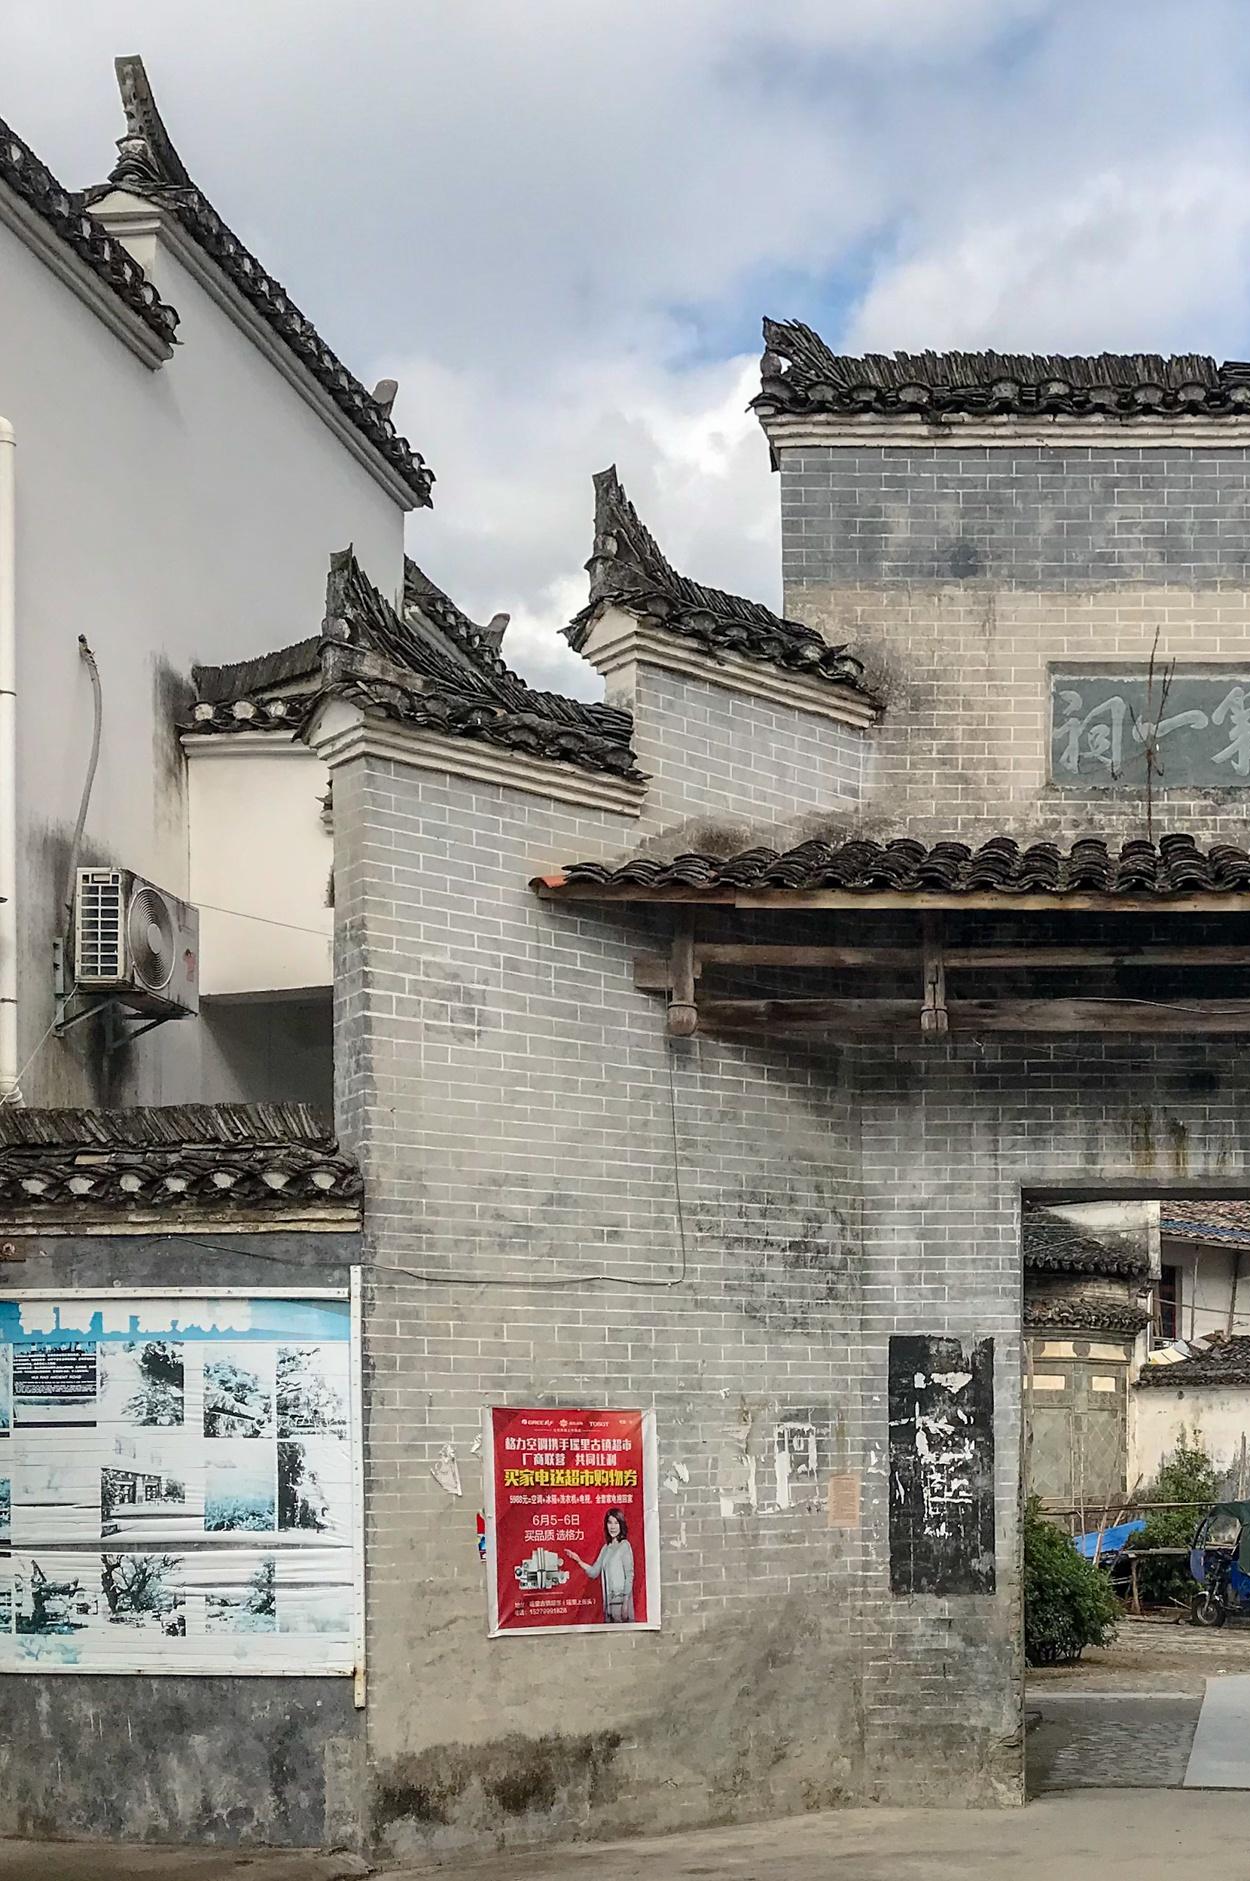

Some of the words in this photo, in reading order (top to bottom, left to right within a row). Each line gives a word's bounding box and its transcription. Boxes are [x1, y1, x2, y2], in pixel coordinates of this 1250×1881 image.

[522, 1453, 566, 1466] 厂商联营
[575, 1453, 617, 1466] 共同让利
[503, 1469, 638, 1487] 买家电送超市购物券
[532, 1514, 580, 1526] 6月5-6日
[524, 1530, 555, 1542] 买品质
[556, 1529, 585, 1541] 选格力
